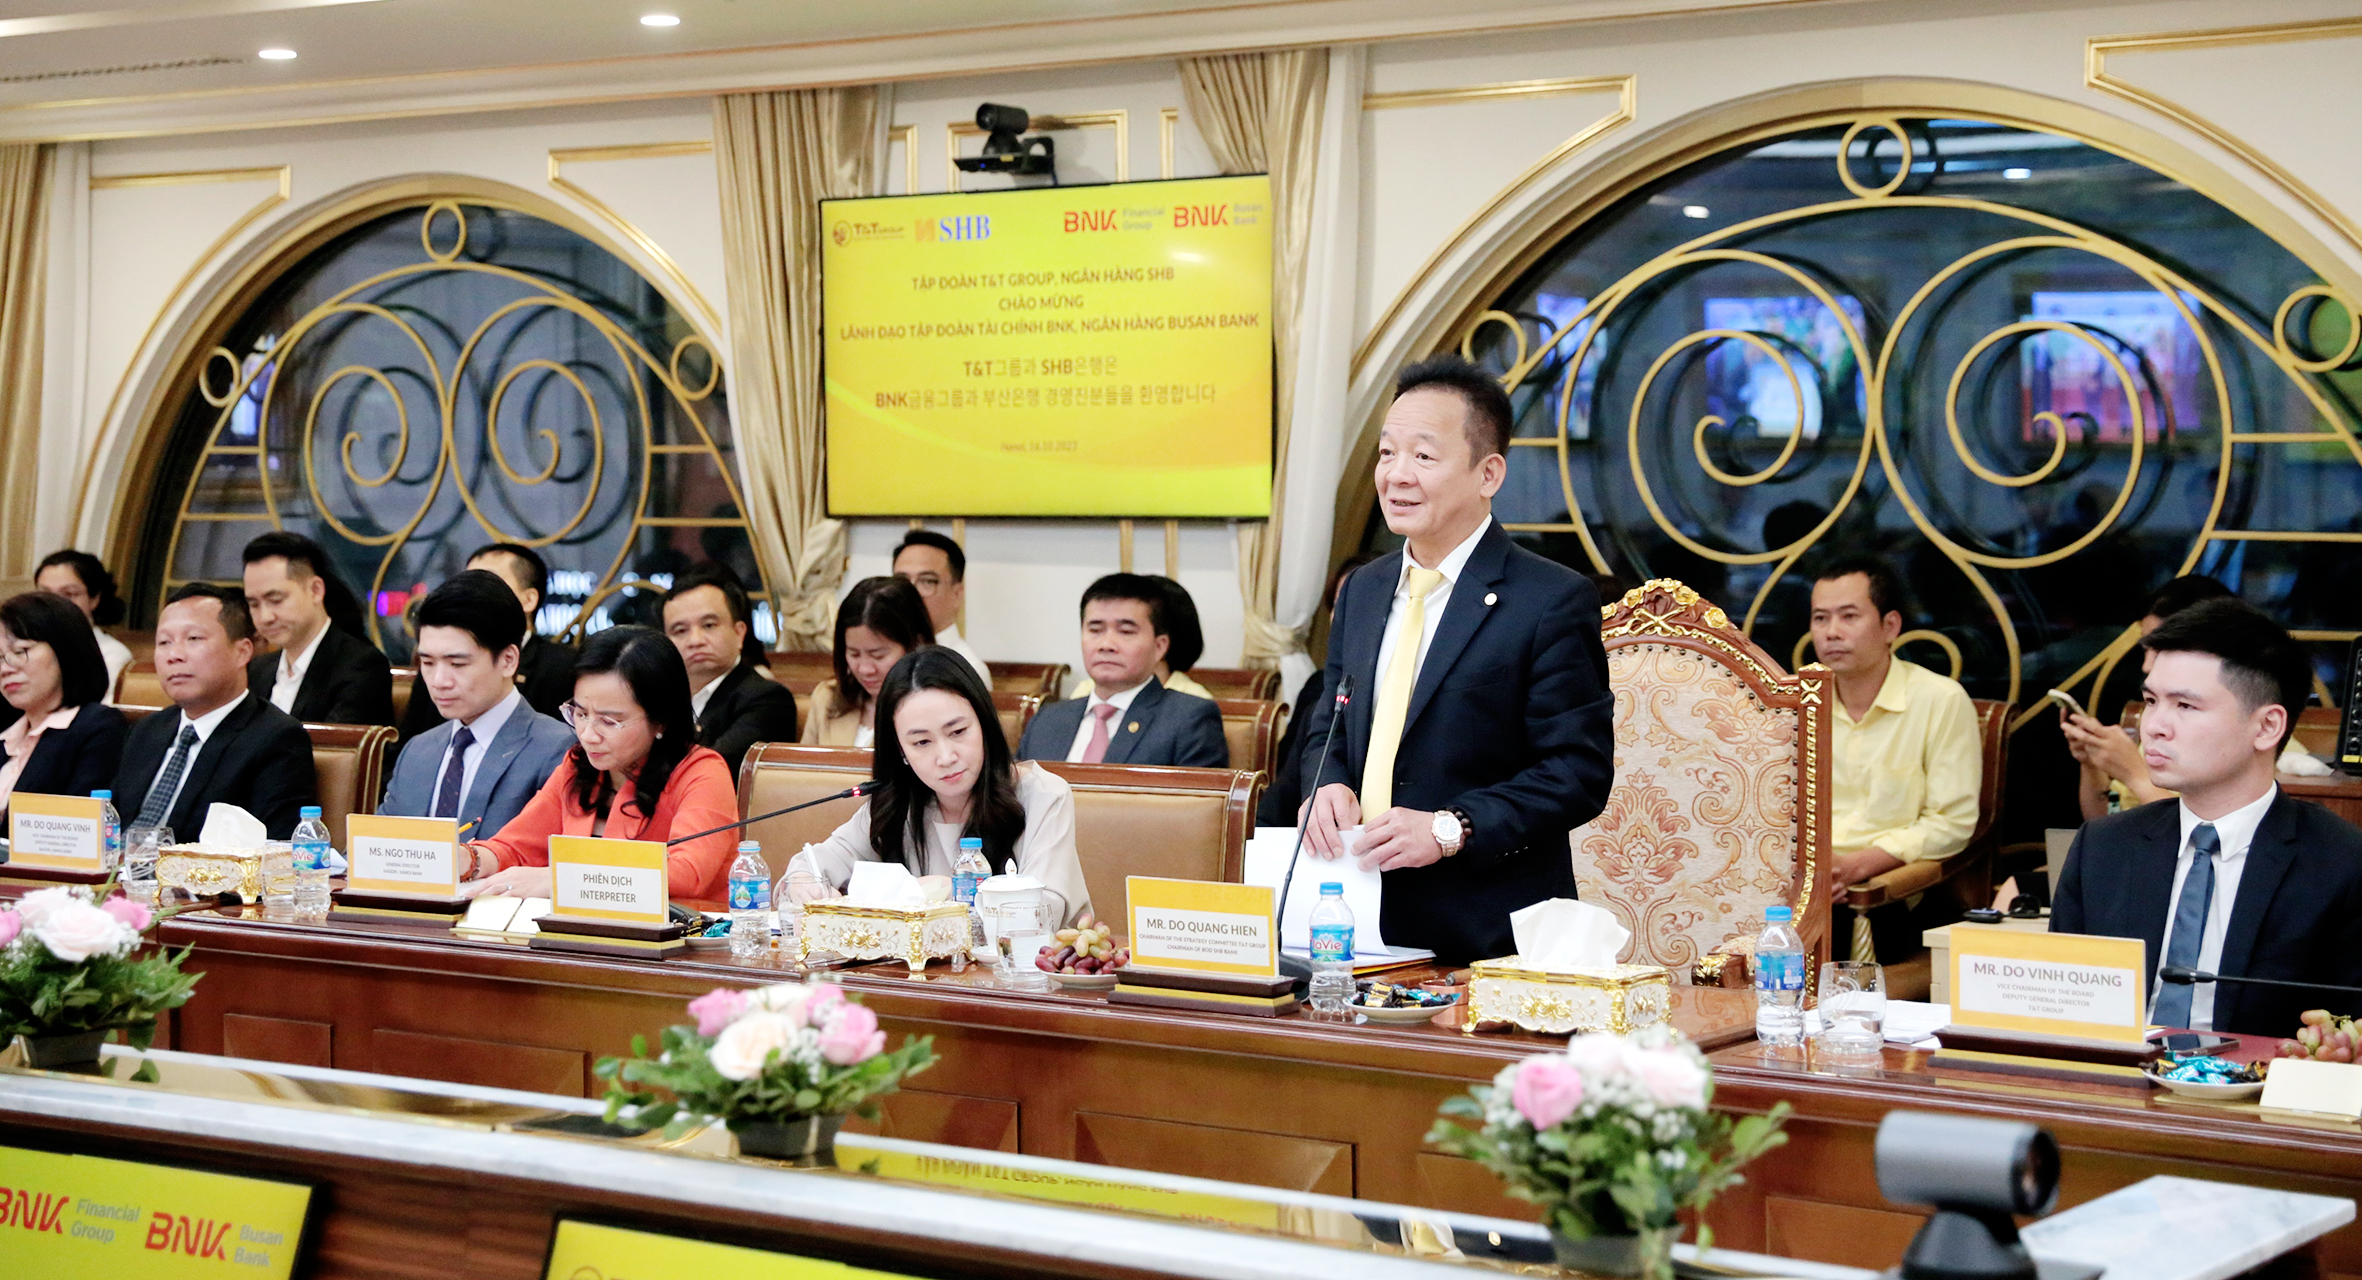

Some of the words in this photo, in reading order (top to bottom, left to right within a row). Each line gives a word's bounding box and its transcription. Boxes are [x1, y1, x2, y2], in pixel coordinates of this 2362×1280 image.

[1064, 209, 1117, 233] BNK
[1122, 220, 1153, 231] Group
[1174, 204, 1228, 228] BNK
[1233, 216, 1258, 226] Bank
[939, 215, 991, 242] SHB
[911, 274, 935, 293] TẬP
[939, 272, 977, 290] ĐOÀN
[981, 274, 1005, 289] T&T
[1061, 267, 1100, 284] NGÂN
[1103, 265, 1144, 282] HÀNG
[1147, 266, 1175, 281] SHB
[998, 292, 1037, 311] CHÀO
[840, 323, 875, 341] LÃNH
[878, 325, 906, 343] ĐẠO
[909, 321, 934, 340] TẬP
[936, 319, 974, 338] ĐOÀN
[977, 318, 998, 336] TÀI
[1000, 318, 1042, 335] CHÍNH
[1081, 315, 1120, 332] NGÂN
[1124, 313, 1164, 330] HÀNG
[1168, 314, 1216, 330] BUSAN
[1219, 312, 1260, 328] BANK
[964, 357, 1037, 378] T&T그룹과
[1041, 355, 1117, 377] SHB은행은
[875, 388, 979, 410] BNK금융그룹과
[983, 387, 1040, 408] 부산은행
[1045, 384, 1134, 407] 경영진분들을
[1139, 383, 1216, 405] 환영합니다
[34, 820, 45, 830] DO
[46, 821, 72, 832] QUANG
[73, 823, 91, 833] VINH
[293, 851, 314, 860] aVie
[369, 847, 383, 857] MS.
[385, 848, 403, 858] NGO
[405, 849, 422, 860] THU
[424, 851, 436, 861] HA
[583, 872, 609, 885] PHIÊN
[611, 875, 632, 888] DỊCH
[580, 890, 637, 903] INTERPRETER
[1146, 918, 1166, 929] MR.
[1169, 920, 1185, 931] DO
[1188, 921, 1228, 935] QUANG
[1231, 924, 1257, 937] HIEN
[1139, 933, 1165, 941] CHAIRMAN
[1183, 937, 1208, 945] STRATEGY
[1208, 939, 1237, 947] COMMITTEE
[1167, 944, 1193, 952] CHAIRMAN
[1974, 962, 1999, 976] MR.
[2003, 964, 2024, 978] DO
[2028, 967, 2064, 982] VINH
[2068, 970, 2122, 987] QUANG
[2002, 992, 2028, 1001] DEPUTY
[2028, 995, 2057, 1004] GENERAL
[2058, 998, 2090, 1007] DIRECTOR
[2011, 983, 2046, 993] CHAIRMAN
[2058, 988, 2070, 996] THE
[2071, 989, 2094, 998] BOARD
[2041, 1006, 2064, 1014] GROUP
[76, 1197, 141, 1222] Financial
[71, 1220, 116, 1245] Group
[144, 1211, 233, 1261] BNK
[239, 1223, 285, 1246] Busan
[233, 1246, 271, 1268] Bank
